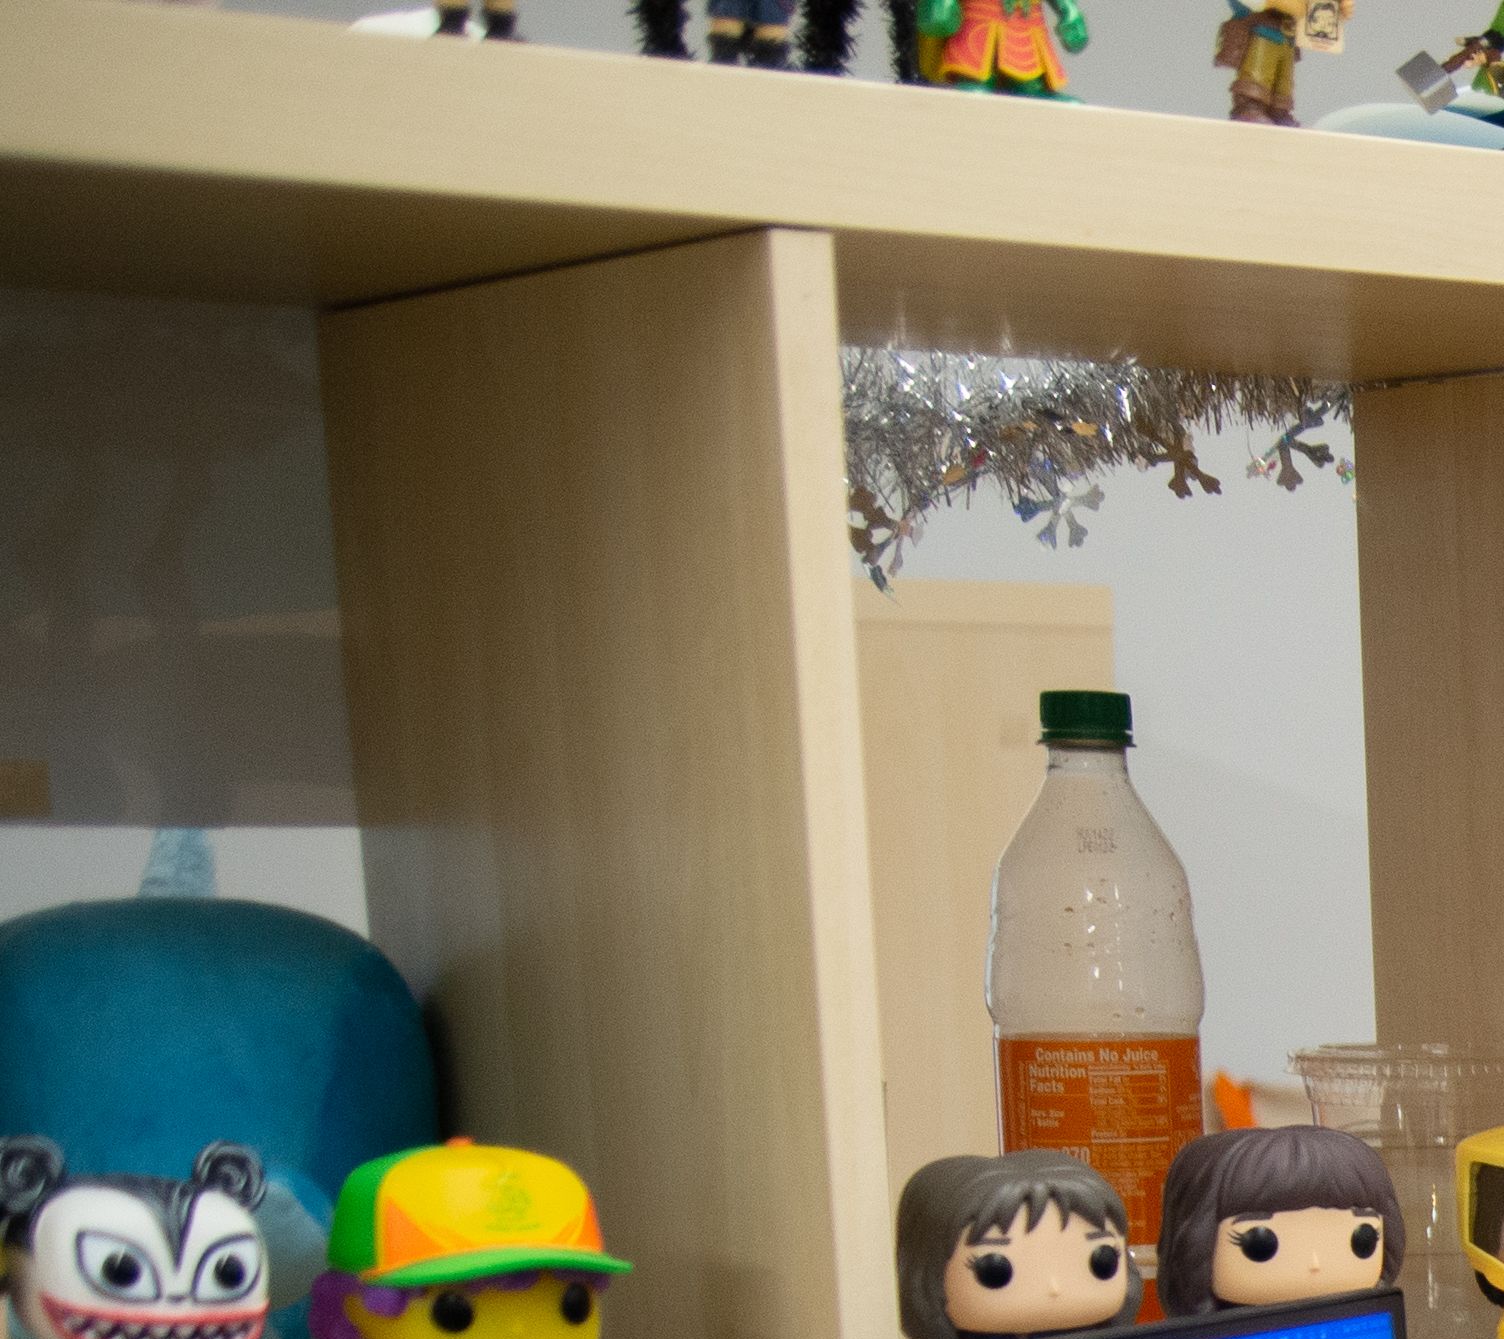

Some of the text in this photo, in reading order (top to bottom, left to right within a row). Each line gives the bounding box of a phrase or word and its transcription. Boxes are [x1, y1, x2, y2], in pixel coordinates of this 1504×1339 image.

[1035, 1048, 1159, 1064] Contains No Juice
[1028, 1063, 1088, 1079] Nutrition
[1030, 1080, 1065, 1094] Facts
